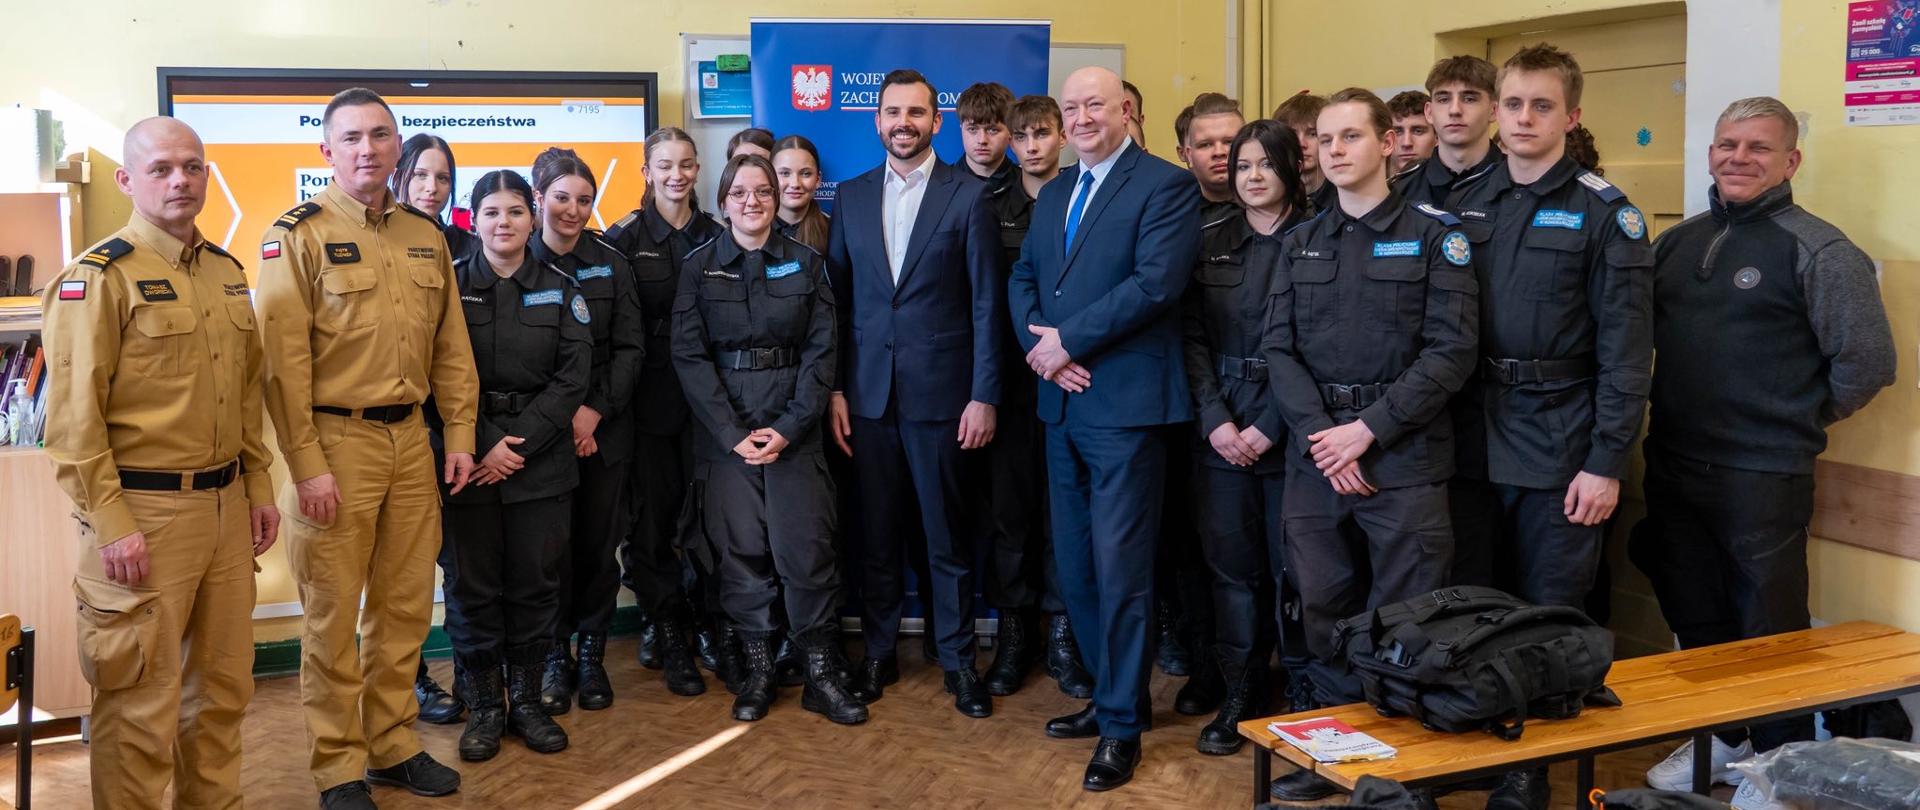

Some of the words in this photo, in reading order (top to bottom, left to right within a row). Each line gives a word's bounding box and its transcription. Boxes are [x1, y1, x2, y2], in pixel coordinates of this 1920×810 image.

[841, 91, 879, 104] ZACH
[578, 104, 600, 114] 7195
[402, 115, 536, 129] bezpieczeństwa
